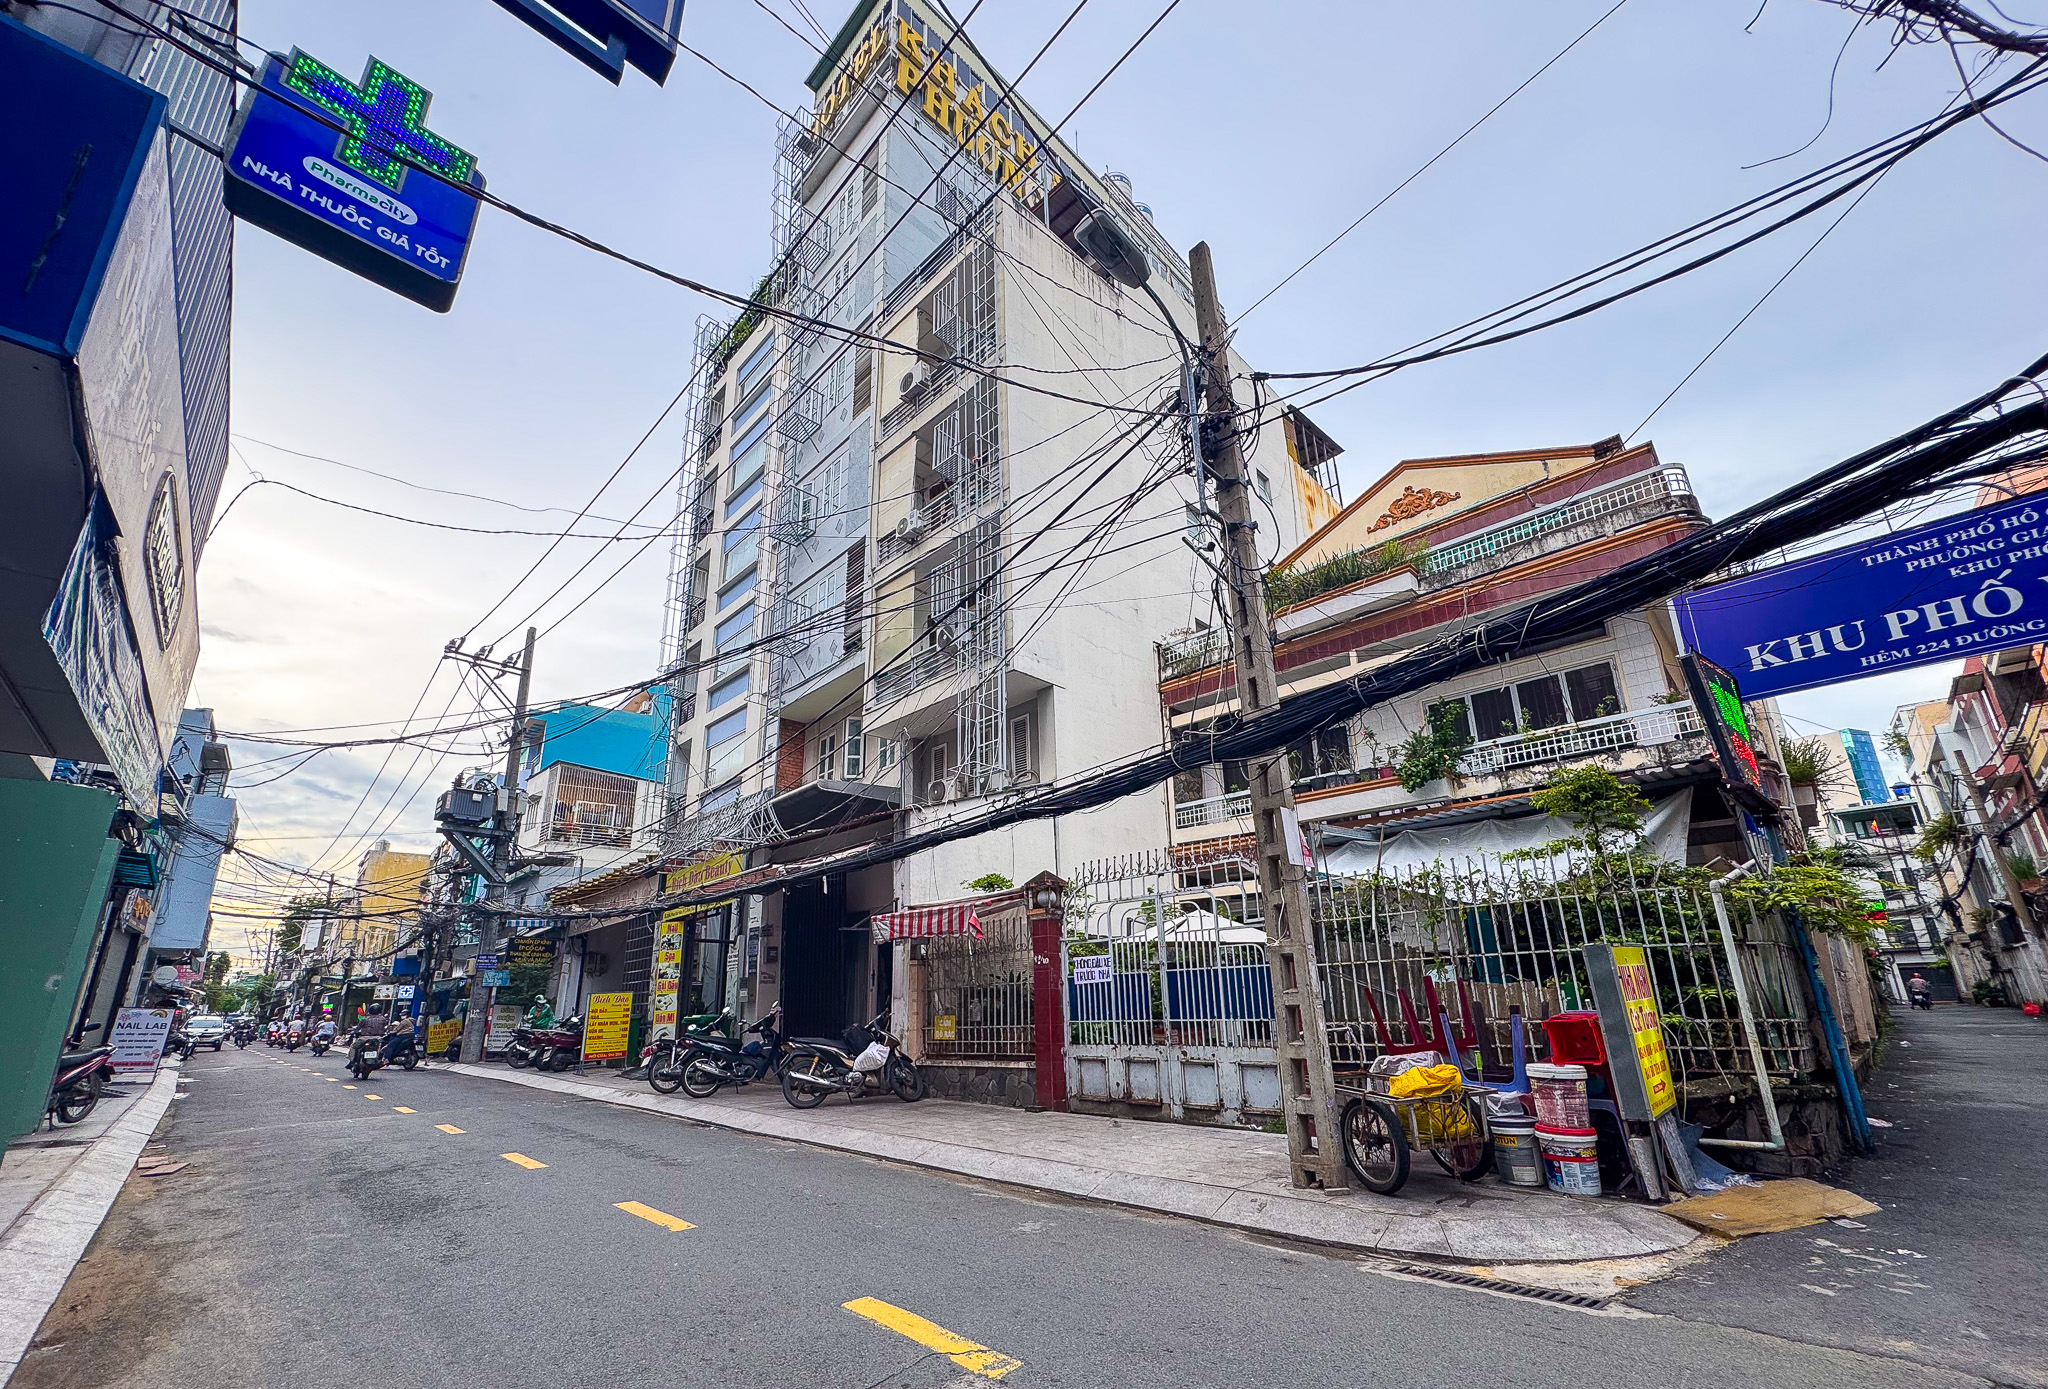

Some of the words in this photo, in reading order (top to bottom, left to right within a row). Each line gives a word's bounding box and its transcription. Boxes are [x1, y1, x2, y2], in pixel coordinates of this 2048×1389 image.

[242, 155, 293, 191] NHÀ
[299, 184, 372, 231] THUỐC
[376, 226, 410, 251] GIÁ
[414, 244, 451, 269] TỐT
[310, 161, 410, 221] Pharmacity
[1861, 537, 1941, 567] THÀNH
[1944, 517, 1996, 545] PHỐ
[2000, 507, 2040, 530] HỒ
[1905, 537, 2006, 573] PHƯỜNG
[1948, 556, 2001, 578] KHU
[1744, 619, 1865, 672] KHU
[1881, 568, 2024, 642] PHỐ
[1859, 647, 1912, 667] HẺM
[1916, 639, 1950, 655] 224
[1955, 618, 2047, 647] ĐƯỜNG
[665, 951, 675, 962] Spa
[116, 1022, 142, 1030] NAIL
[145, 1022, 168, 1030] LAB
[1495, 1136, 1516, 1145] OTUN
